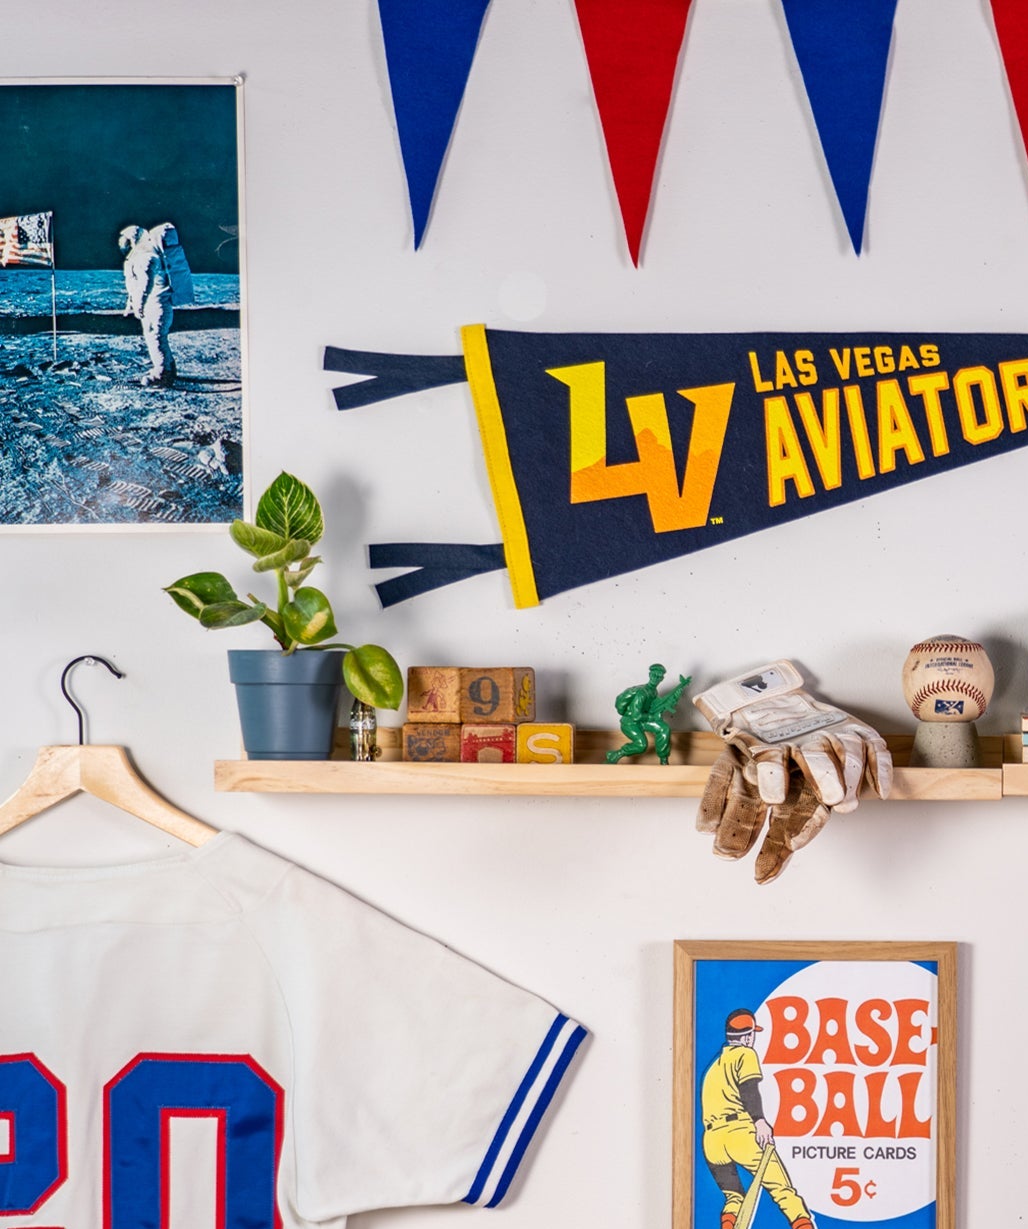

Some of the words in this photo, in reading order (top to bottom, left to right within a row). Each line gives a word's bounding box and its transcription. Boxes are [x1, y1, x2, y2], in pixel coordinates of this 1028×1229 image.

[748, 348, 818, 393] LAS
[834, 343, 942, 381] VEGAS
[467, 676, 500, 717] 9
[526, 732, 563, 764] S
[772, 1067, 933, 1139] BALL
[791, 1146, 857, 1161] PICTURE
[863, 1146, 917, 1161] CARDS
[830, 1166, 878, 1207] 5¢
